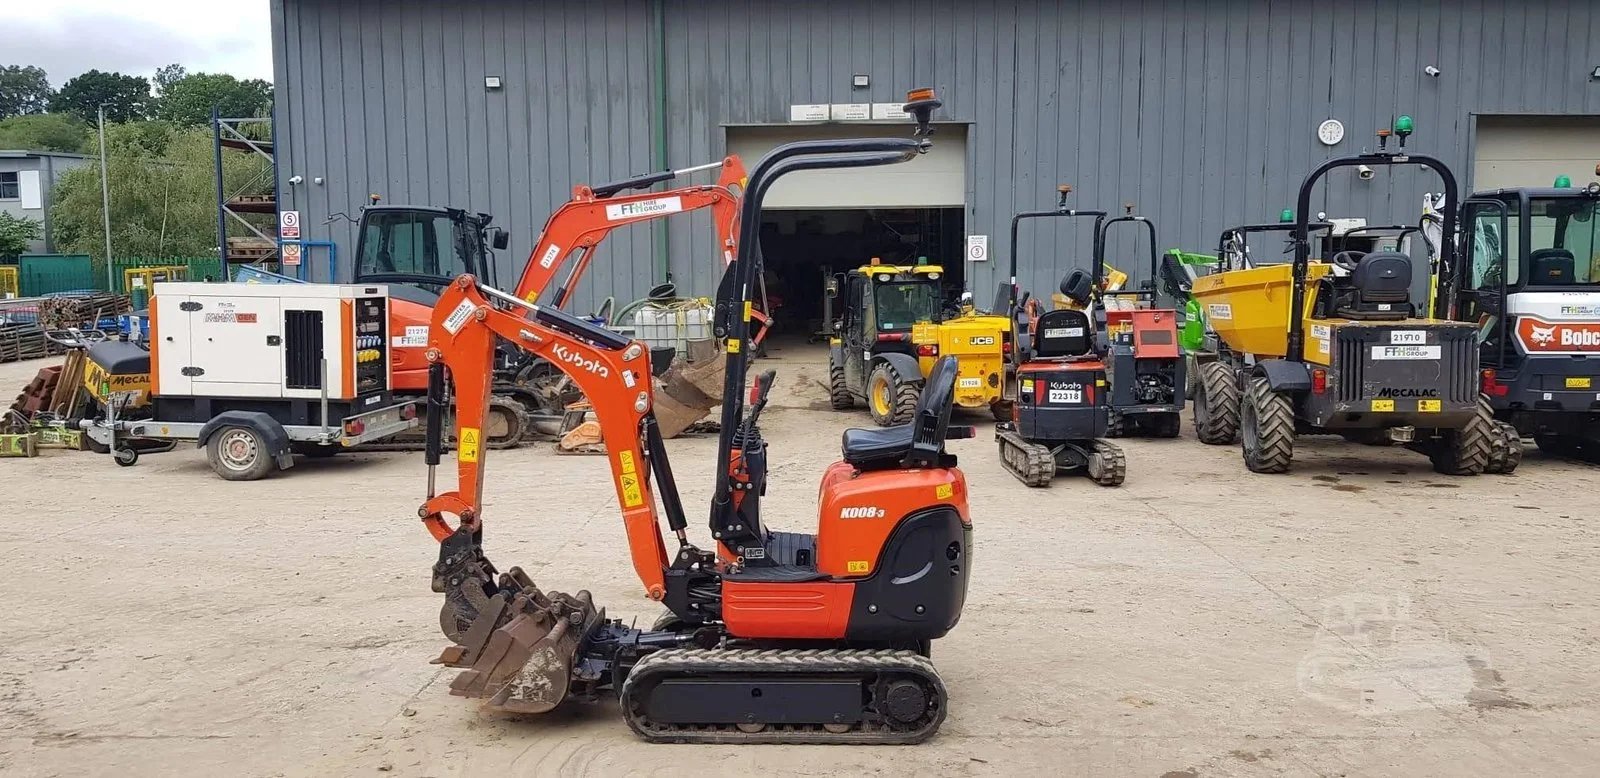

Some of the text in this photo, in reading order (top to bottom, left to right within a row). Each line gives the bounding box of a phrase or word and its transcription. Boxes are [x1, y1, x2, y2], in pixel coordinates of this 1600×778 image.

[621, 203, 643, 214] FTH
[643, 204, 667, 212] GROUP
[287, 215, 293, 224] 5
[970, 337, 994, 345] JCB
[1384, 347, 1406, 356] FTH
[552, 343, 609, 378] Kubota
[1050, 382, 1082, 390] Kubota
[840, 507, 885, 518] K008-3
